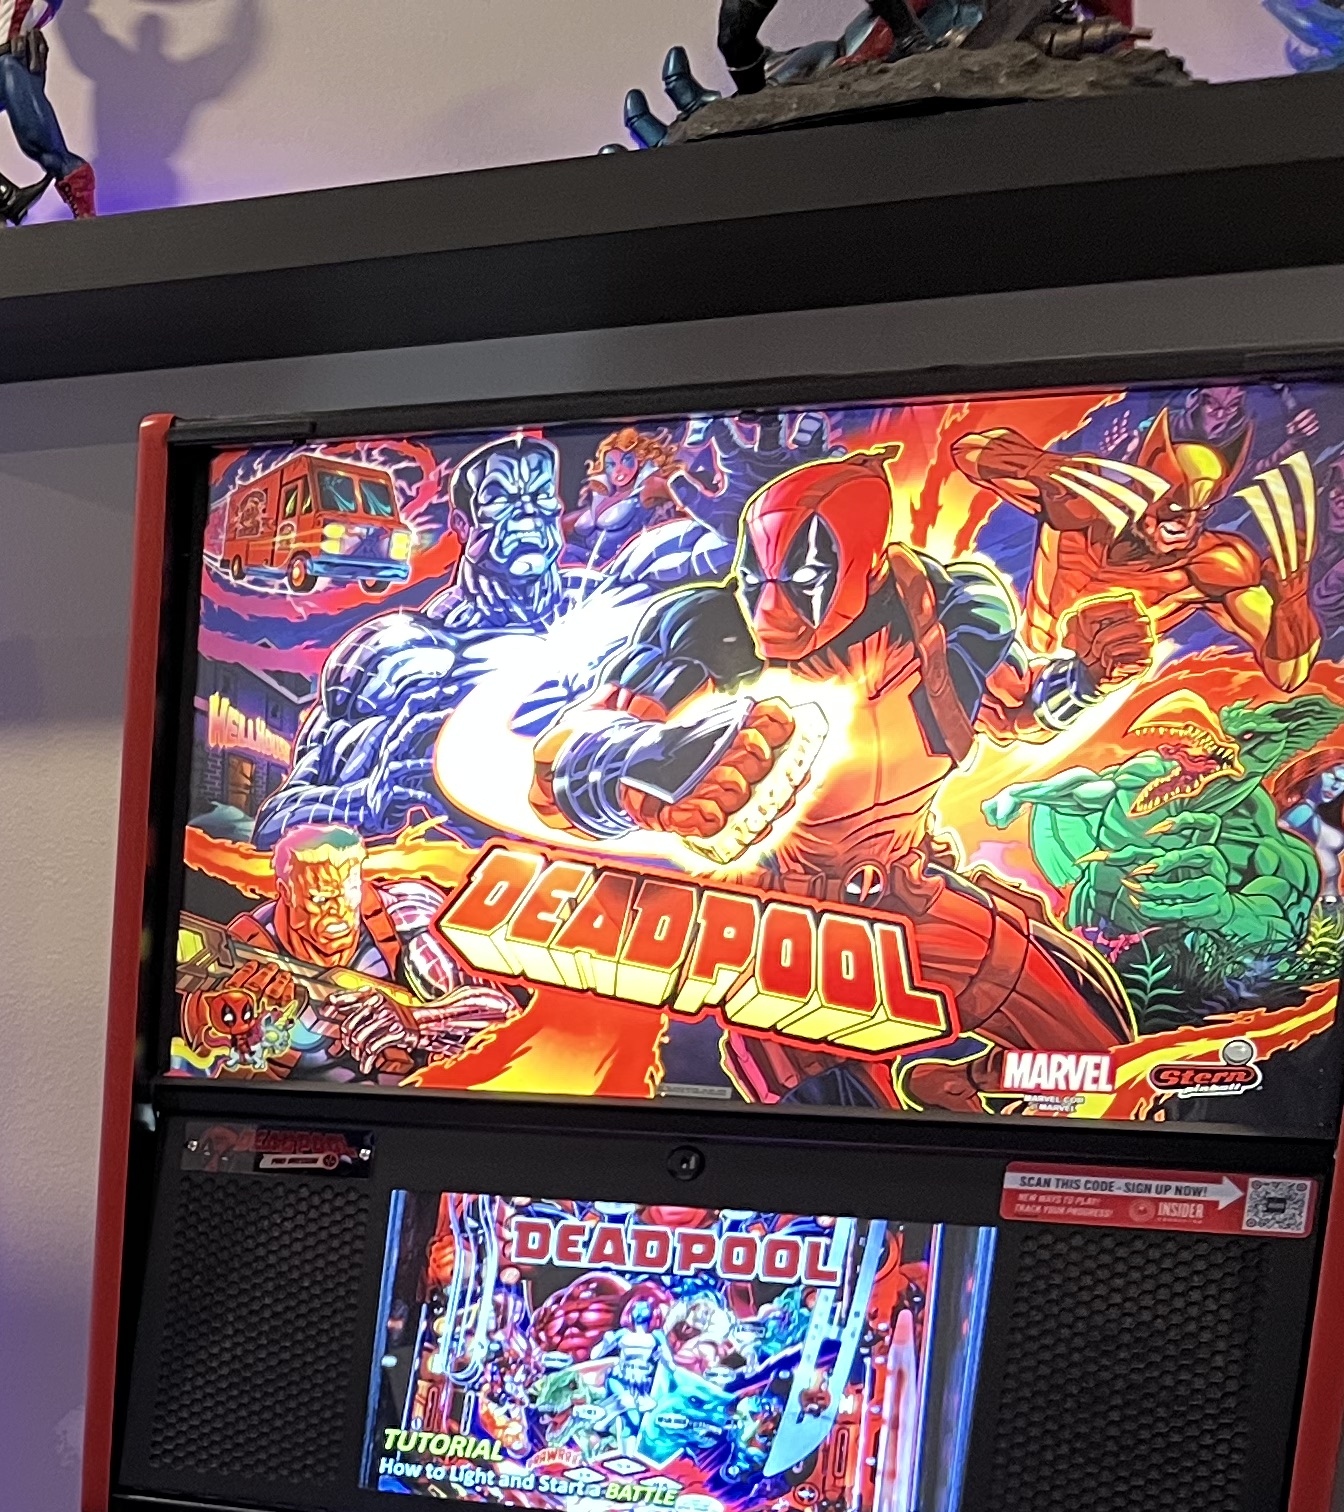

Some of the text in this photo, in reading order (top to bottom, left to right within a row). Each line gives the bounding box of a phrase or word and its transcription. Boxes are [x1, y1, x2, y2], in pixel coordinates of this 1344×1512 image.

[438, 848, 949, 1050] DEADPOOL
[1003, 1052, 1112, 1090] MARVEL
[1160, 1069, 1249, 1086] Stern
[1019, 1176, 1052, 1189] SCAN
[1054, 1177, 1082, 1191] THIS
[1083, 1180, 1115, 1192] CODE
[1123, 1181, 1153, 1195] SIGN
[1156, 1183, 1172, 1196] UP
[1173, 1185, 1208, 1198] NOW!
[1014, 1203, 1042, 1214] TRACK
[1043, 1205, 1065, 1216] YOUR
[1157, 1201, 1204, 1219] INSIDER
[511, 1216, 842, 1287] DEADPOOL
[385, 1428, 504, 1461] TUTORIAL
[379, 1458, 422, 1477] How
[425, 1462, 446, 1480] to
[450, 1464, 494, 1490] Light
[498, 1472, 535, 1491] and
[539, 1477, 584, 1497] Start
[605, 1483, 678, 1505] BATTLE
